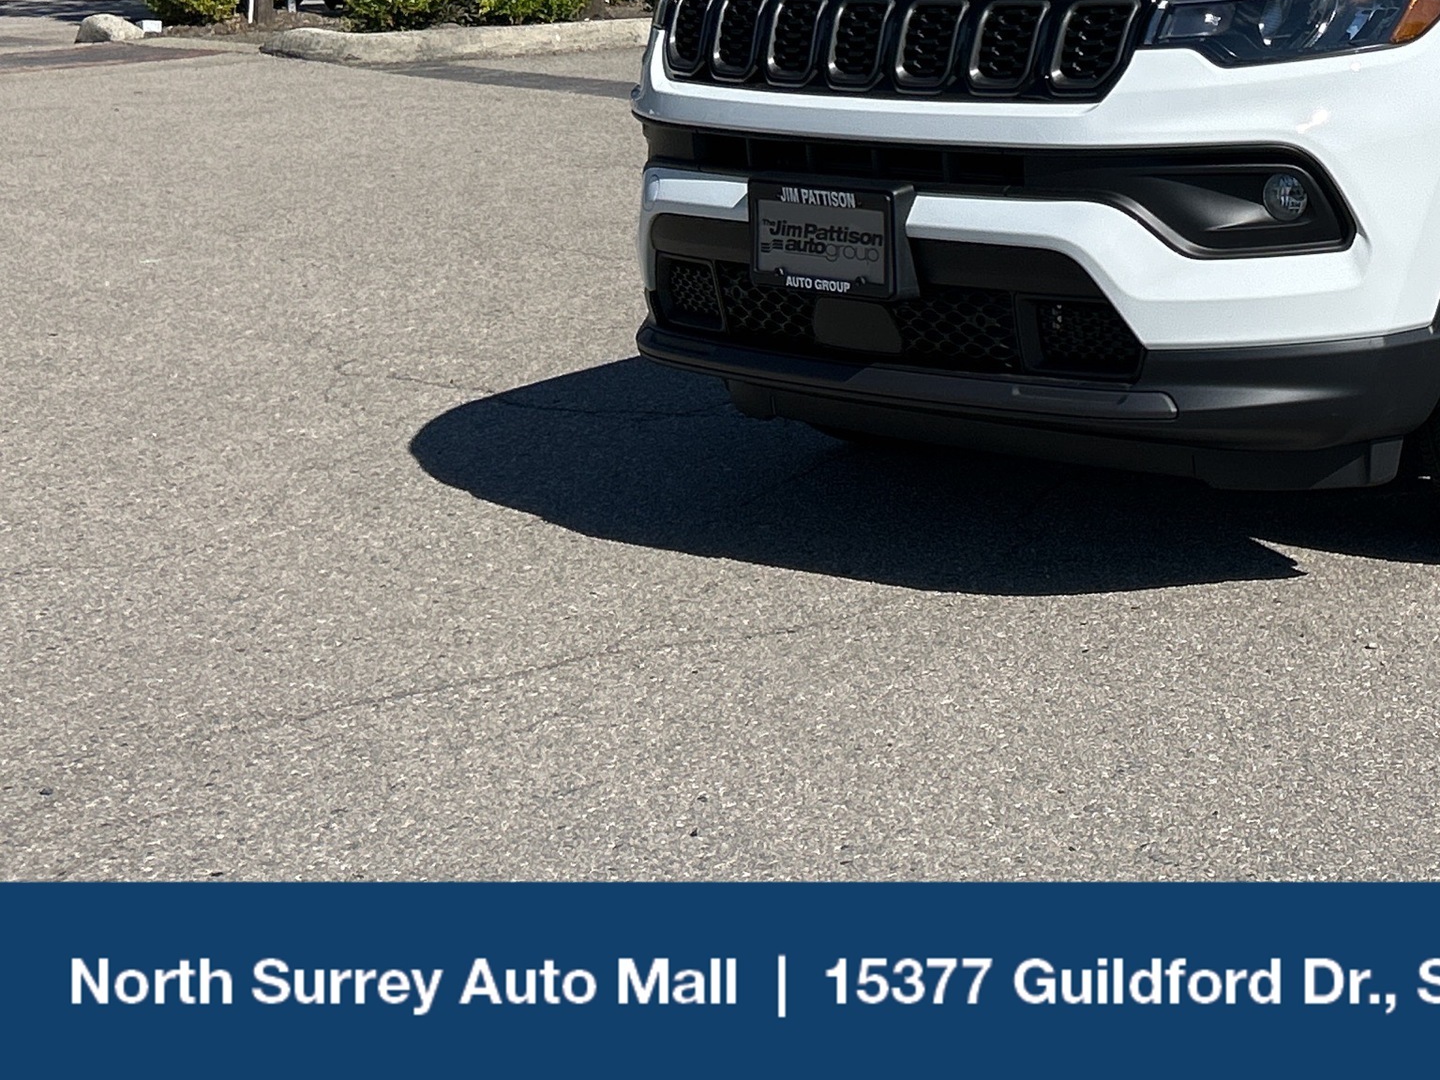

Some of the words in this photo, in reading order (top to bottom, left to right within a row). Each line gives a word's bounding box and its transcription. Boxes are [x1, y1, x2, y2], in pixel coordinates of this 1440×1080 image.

[780, 186, 800, 203] JIM
[801, 189, 857, 209] PATTISON
[785, 275, 813, 289] AUTO
[814, 278, 851, 293] GROUP
